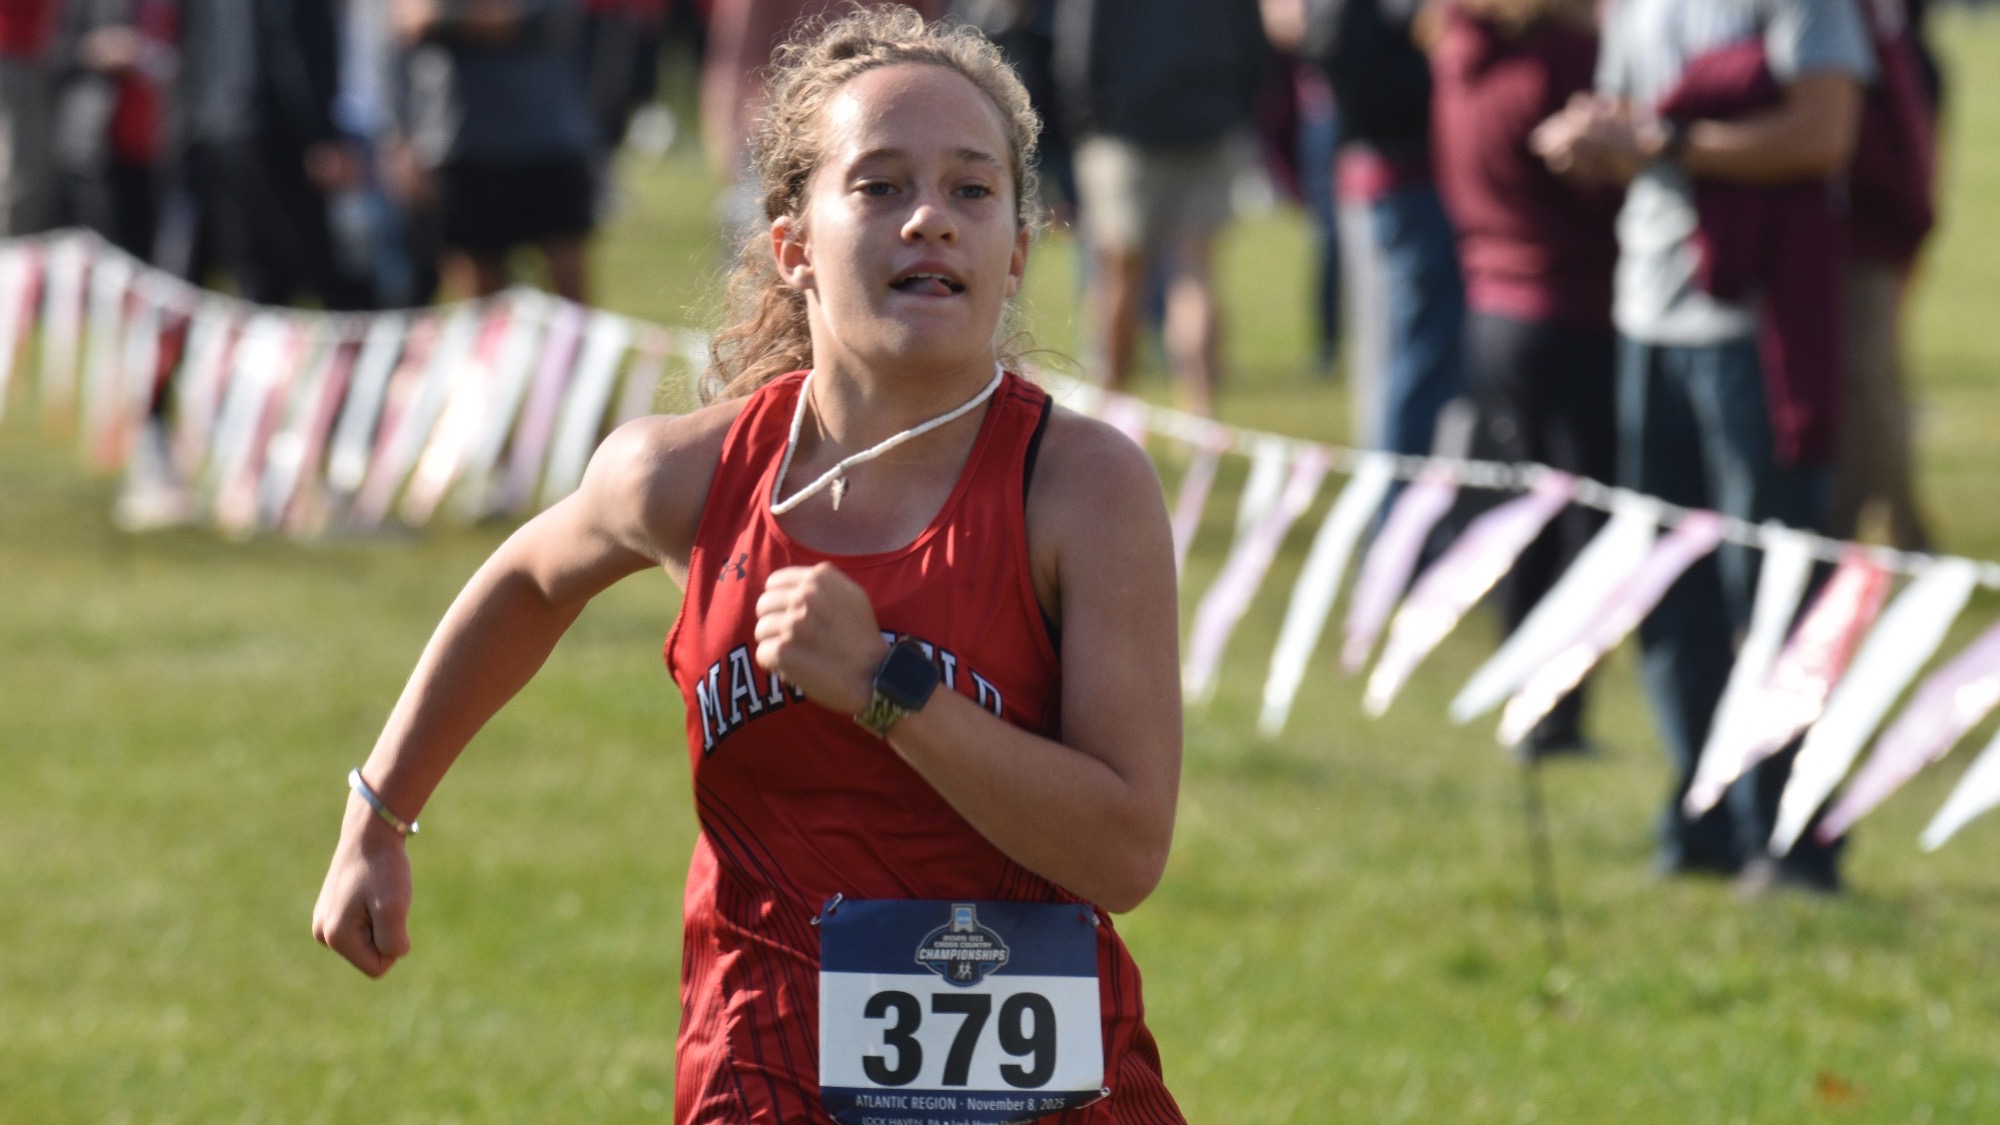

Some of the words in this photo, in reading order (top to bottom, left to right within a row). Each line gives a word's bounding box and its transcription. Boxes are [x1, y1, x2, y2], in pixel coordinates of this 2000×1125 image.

[919, 948, 1006, 960] CHAMPIONSHIPS
[862, 990, 1057, 1089] 379
[855, 1095, 908, 1109] ATLANTIC
[911, 1096, 957, 1110] REGION
[967, 1097, 1025, 1111] November
[1040, 1097, 1066, 1110] 2025
